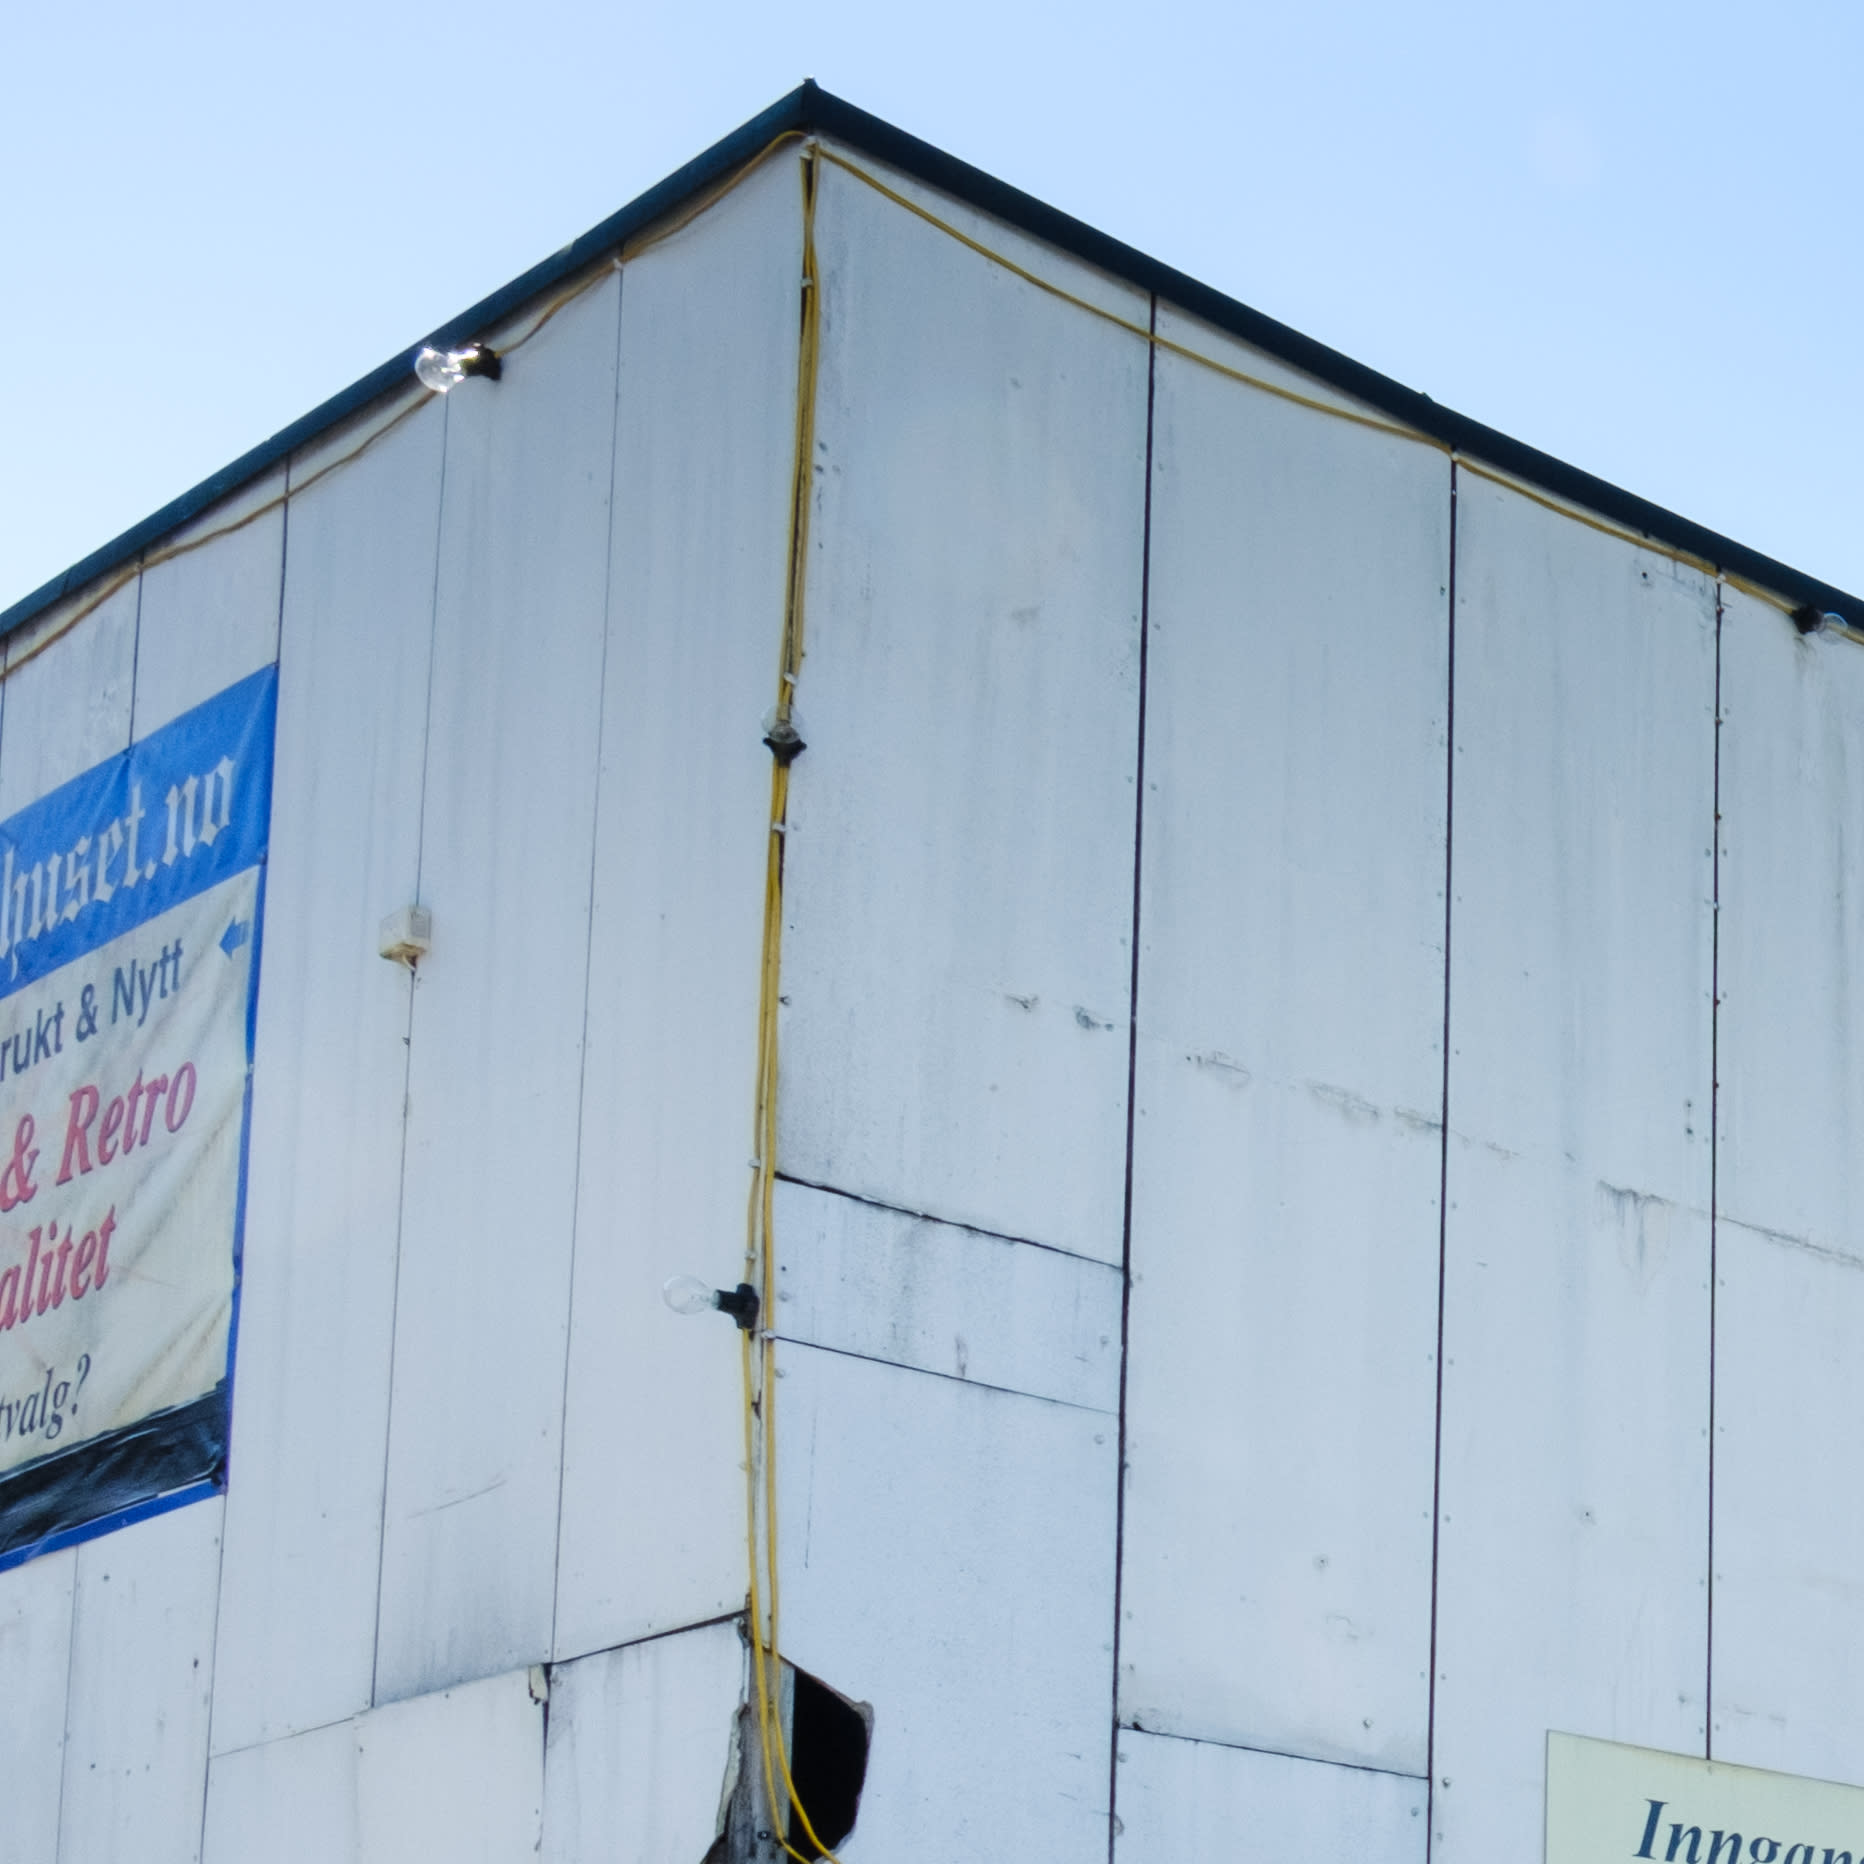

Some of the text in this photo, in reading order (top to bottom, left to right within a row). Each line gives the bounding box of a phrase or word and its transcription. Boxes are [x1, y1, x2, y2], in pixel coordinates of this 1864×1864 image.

[76, 983, 98, 1042] &
[112, 938, 183, 1027] Nytt
[0, 1061, 197, 1213] & Retro
